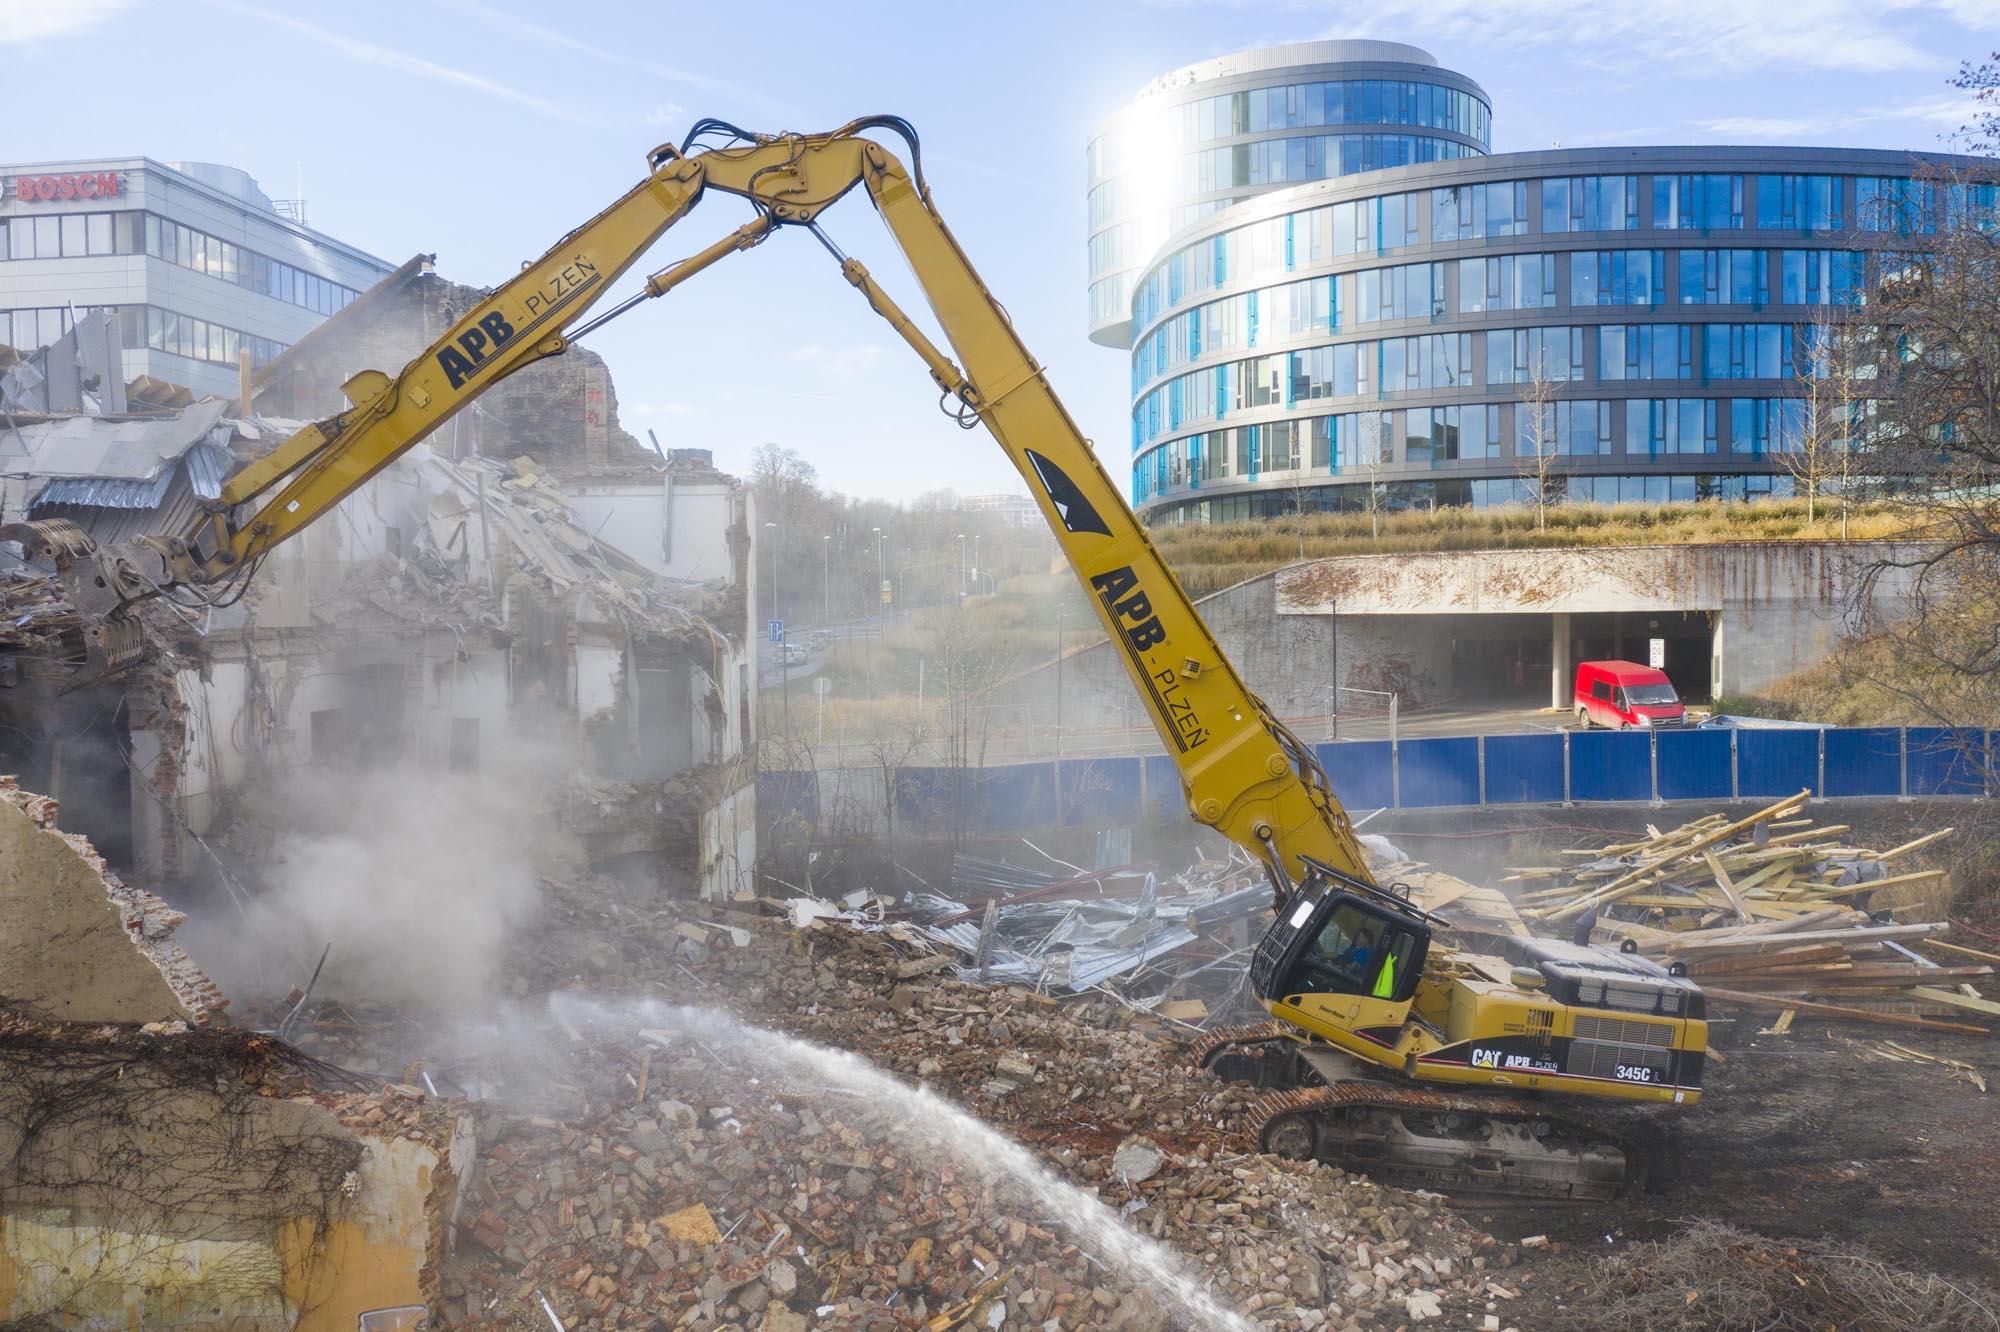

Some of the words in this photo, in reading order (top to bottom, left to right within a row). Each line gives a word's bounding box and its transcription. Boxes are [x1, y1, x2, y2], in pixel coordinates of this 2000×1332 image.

[16, 171, 118, 201] BOSCH
[436, 311, 514, 391] APB
[525, 254, 597, 315] PLZEŇ
[1090, 565, 1166, 652] APB
[1154, 668, 1210, 749] PLZEŇ
[1472, 1048, 1502, 1069] CAT
[1504, 1055, 1530, 1067] APB
[1616, 1065, 1651, 1081] 345C
